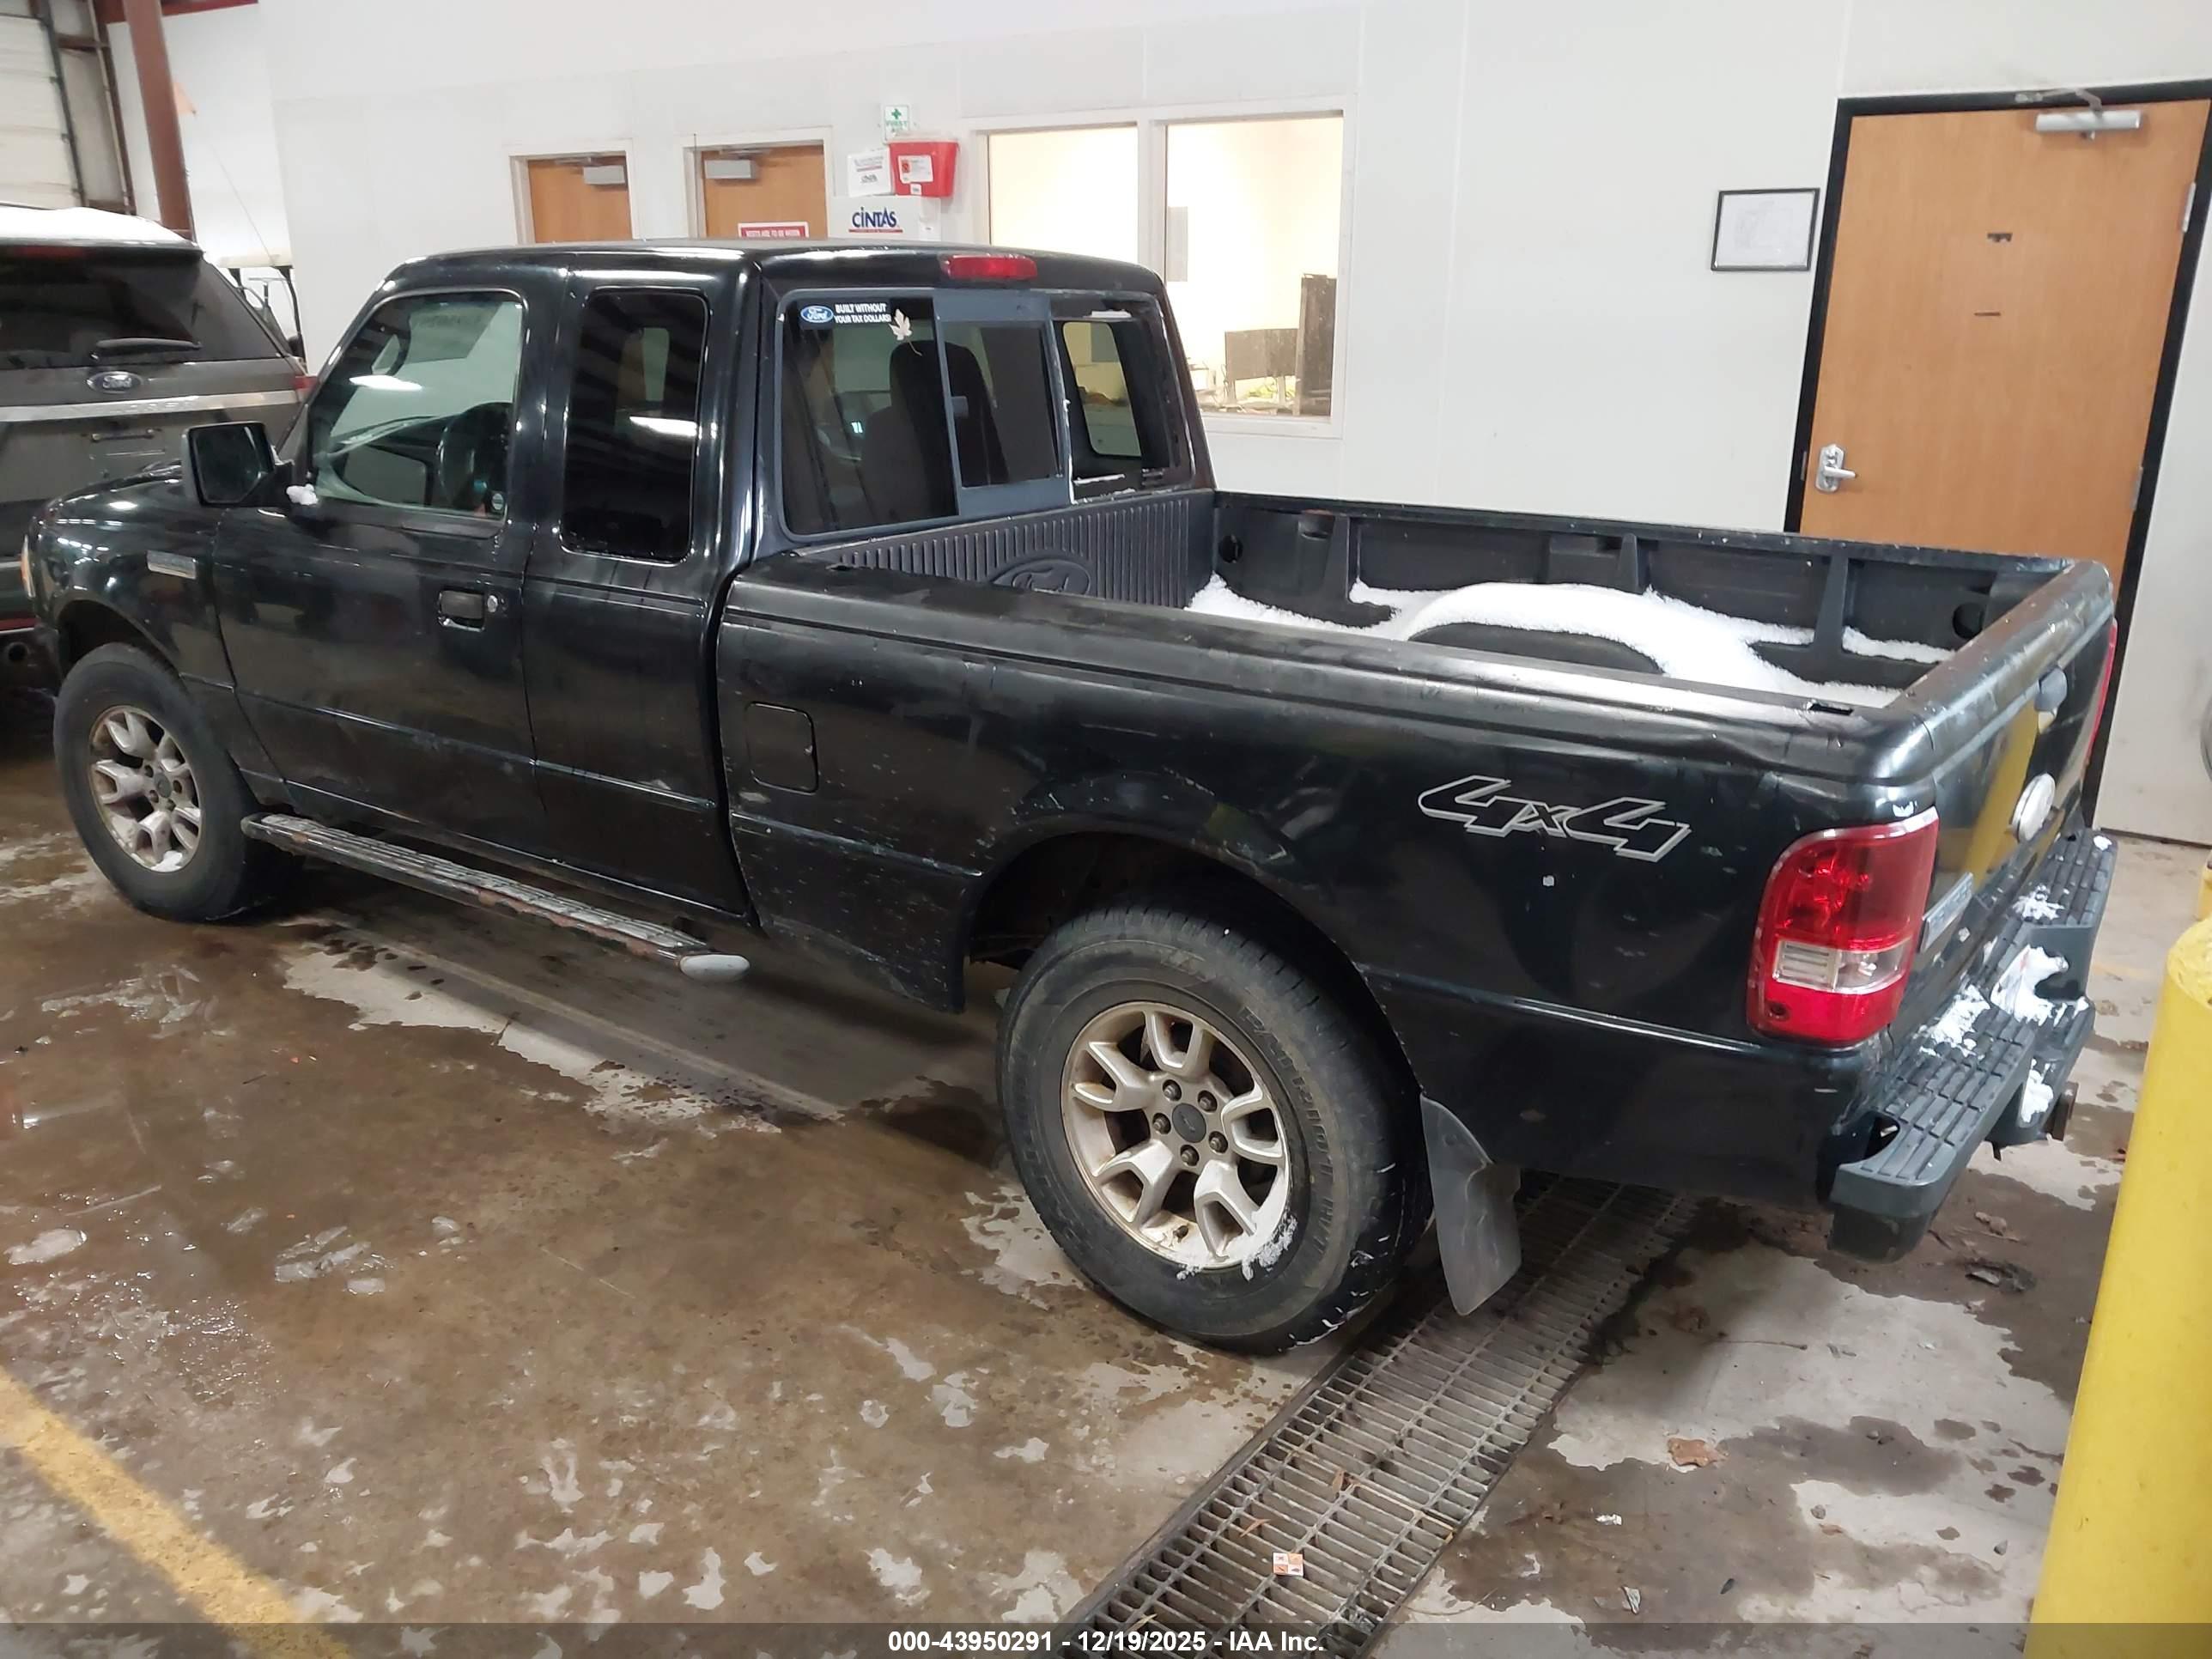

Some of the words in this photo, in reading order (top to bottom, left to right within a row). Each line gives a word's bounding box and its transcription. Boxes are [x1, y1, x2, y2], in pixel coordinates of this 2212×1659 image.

[835, 303, 854, 313] BUILT
[854, 303, 886, 313] WITHOUT
[834, 314, 852, 324] YOUR
[850, 314, 863, 323] TAX
